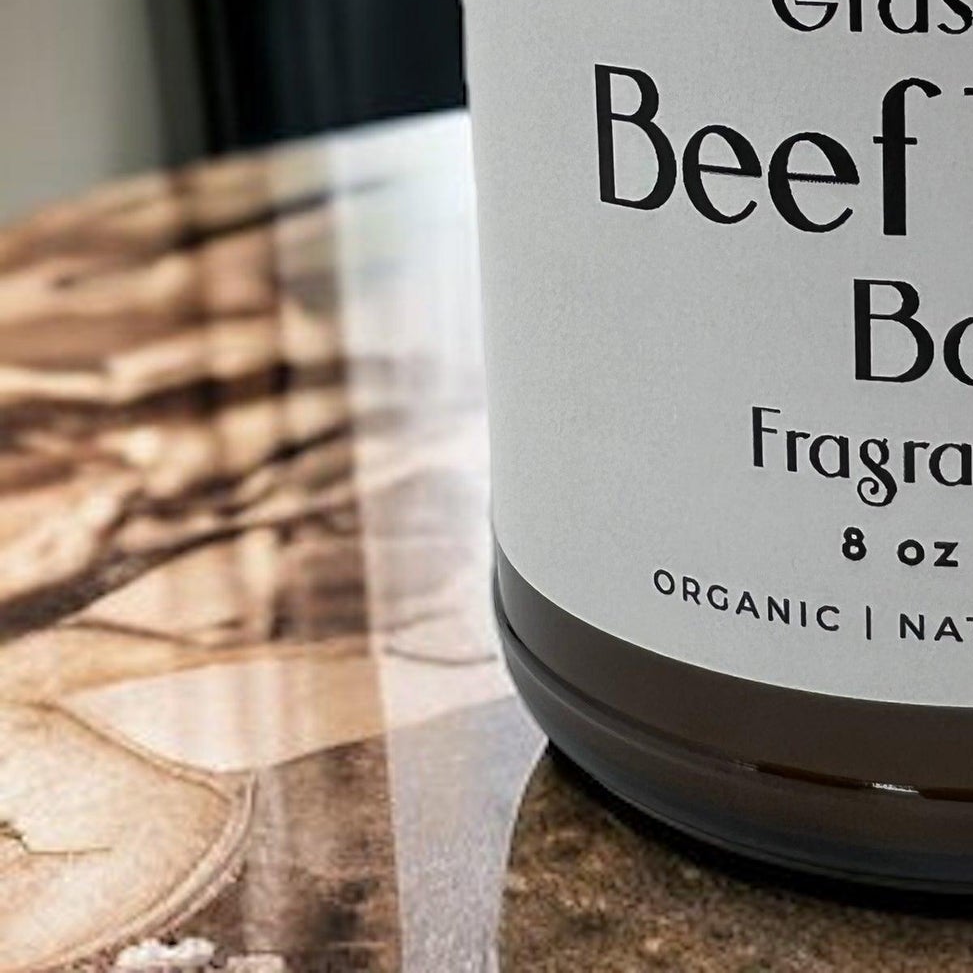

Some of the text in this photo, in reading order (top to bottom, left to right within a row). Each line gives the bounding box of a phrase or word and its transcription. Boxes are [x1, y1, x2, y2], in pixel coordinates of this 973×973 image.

[594, 63, 942, 237] Beef
[841, 526, 868, 562] 8
[896, 538, 959, 568] oz
[653, 569, 841, 632] ORGANIC
